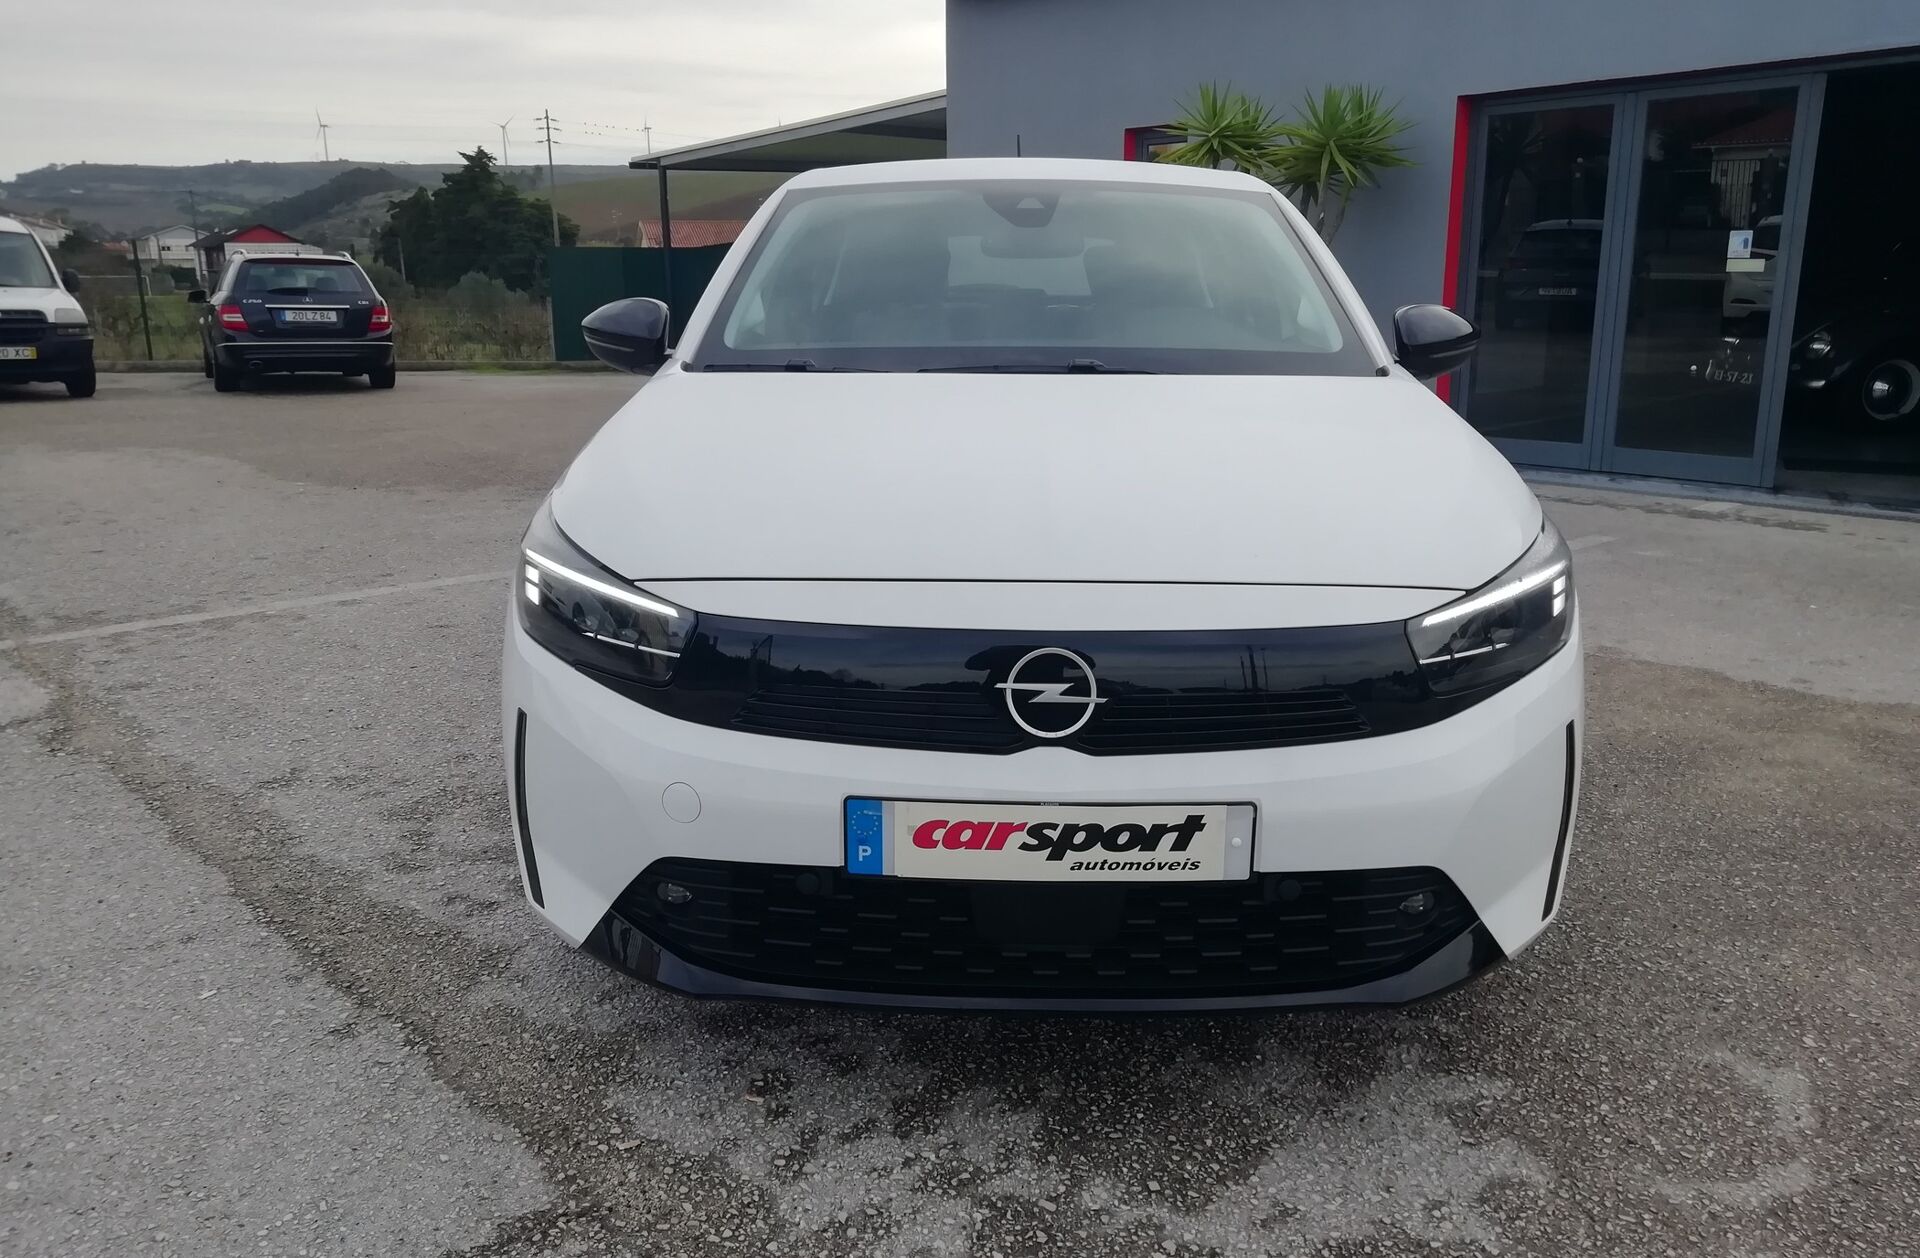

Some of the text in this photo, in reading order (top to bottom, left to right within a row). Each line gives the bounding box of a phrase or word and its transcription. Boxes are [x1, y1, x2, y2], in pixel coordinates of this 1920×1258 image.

[912, 814, 1207, 861] carsport
[858, 845, 872, 862] P
[1069, 857, 1201, 871] automóveis
